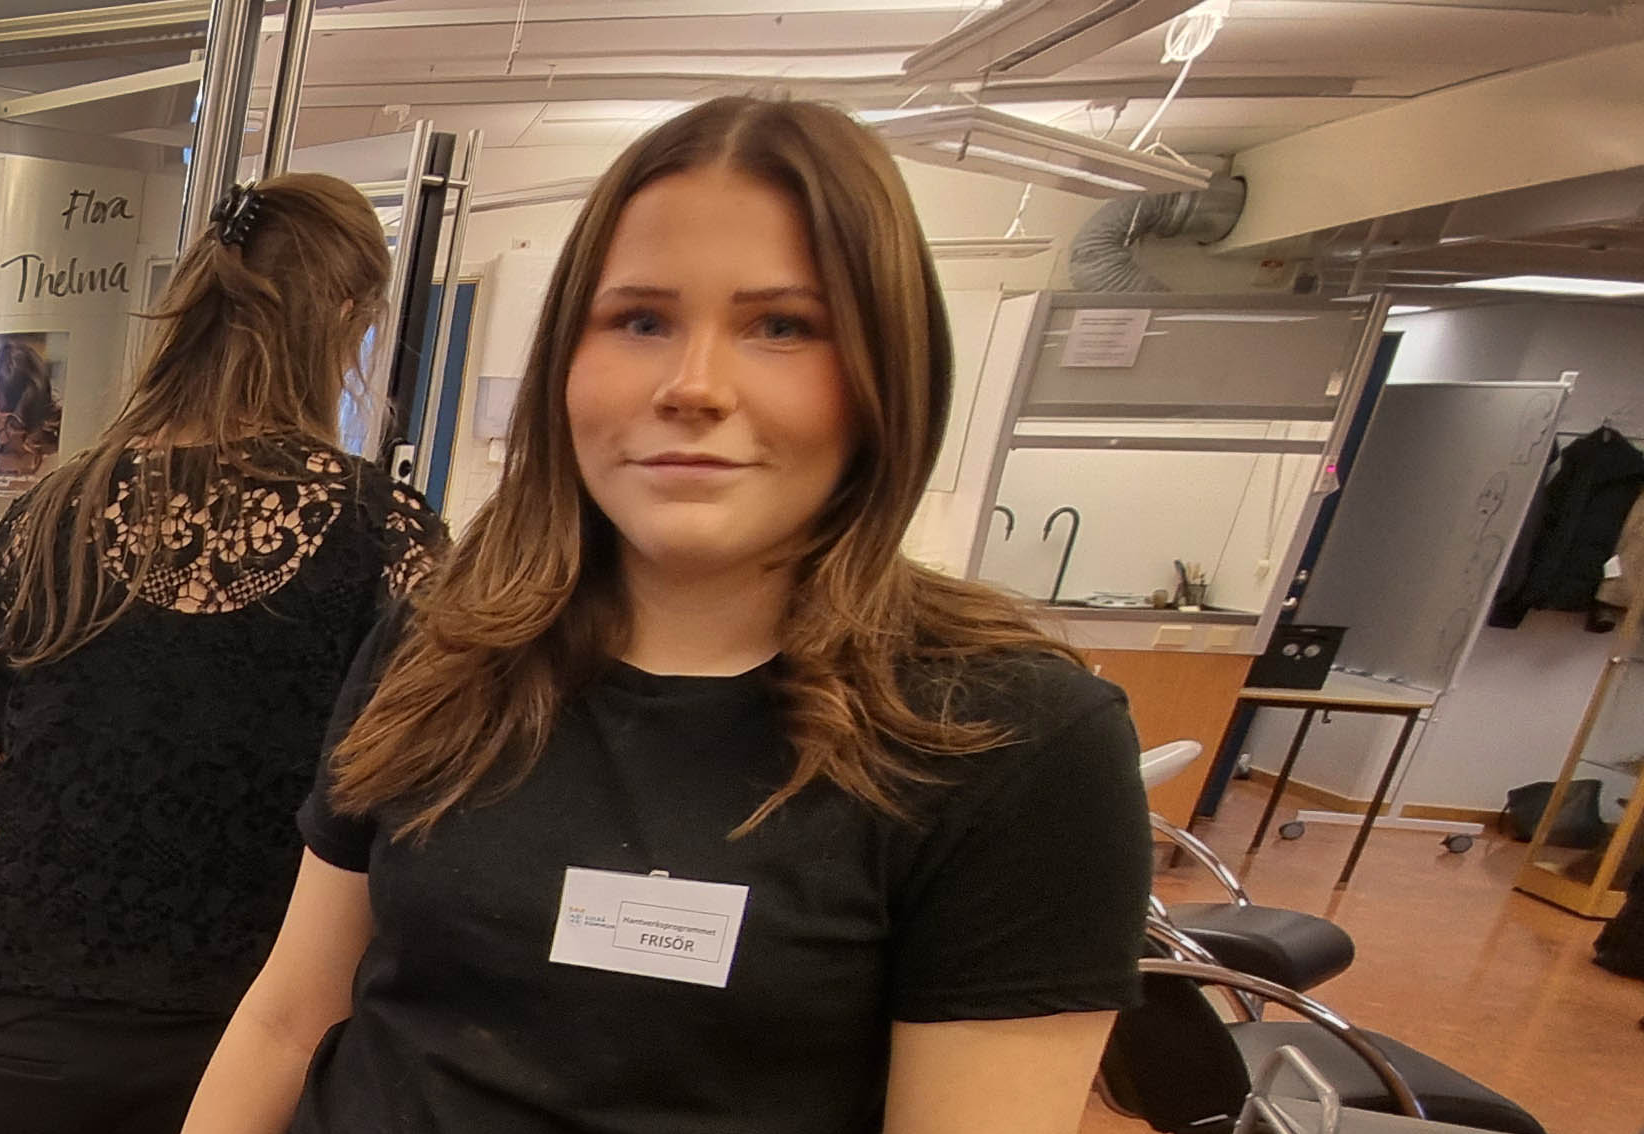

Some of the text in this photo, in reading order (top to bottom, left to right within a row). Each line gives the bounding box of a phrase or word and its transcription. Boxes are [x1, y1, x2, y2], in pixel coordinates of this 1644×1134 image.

[62, 189, 134, 230] Flora
[1, 254, 130, 302] Thelma
[639, 933, 695, 952] FRISÖR
